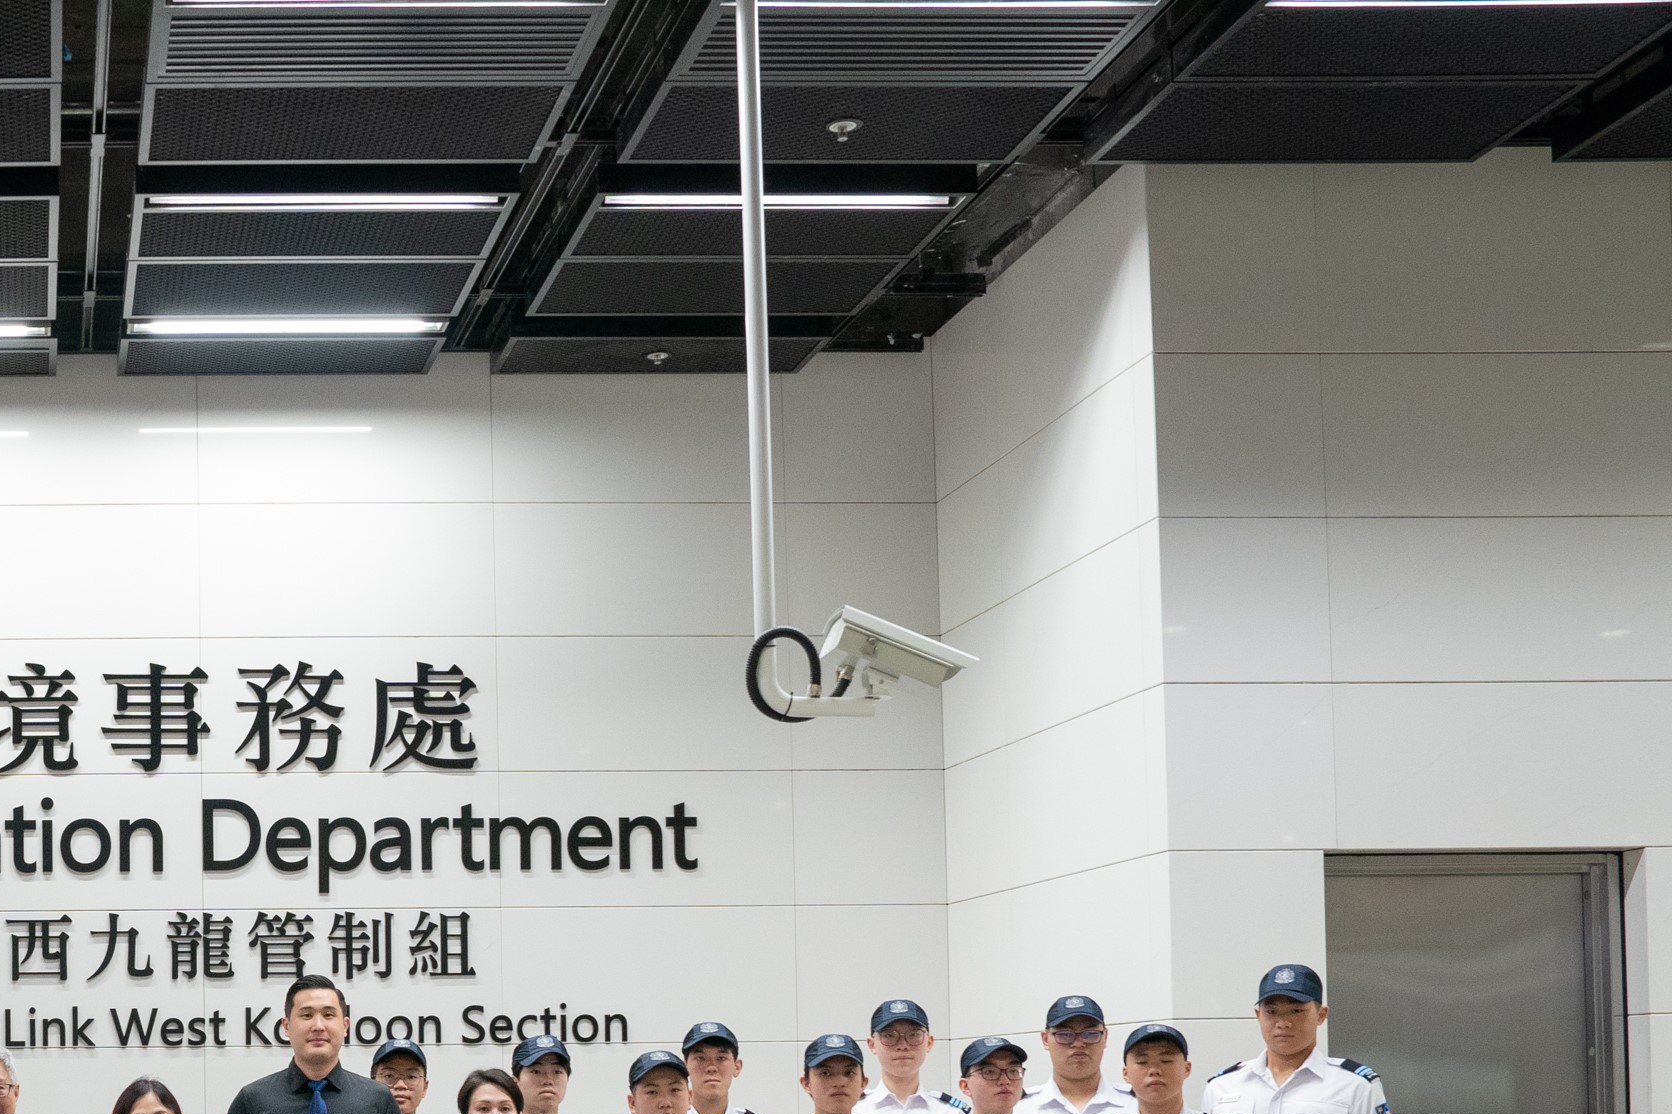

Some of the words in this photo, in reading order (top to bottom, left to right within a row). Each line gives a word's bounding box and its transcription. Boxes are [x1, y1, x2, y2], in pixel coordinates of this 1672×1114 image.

[202, 799, 698, 894] Department
[5, 1006, 95, 1047] Link
[110, 1008, 226, 1046] West
[462, 1003, 629, 1049] Section
